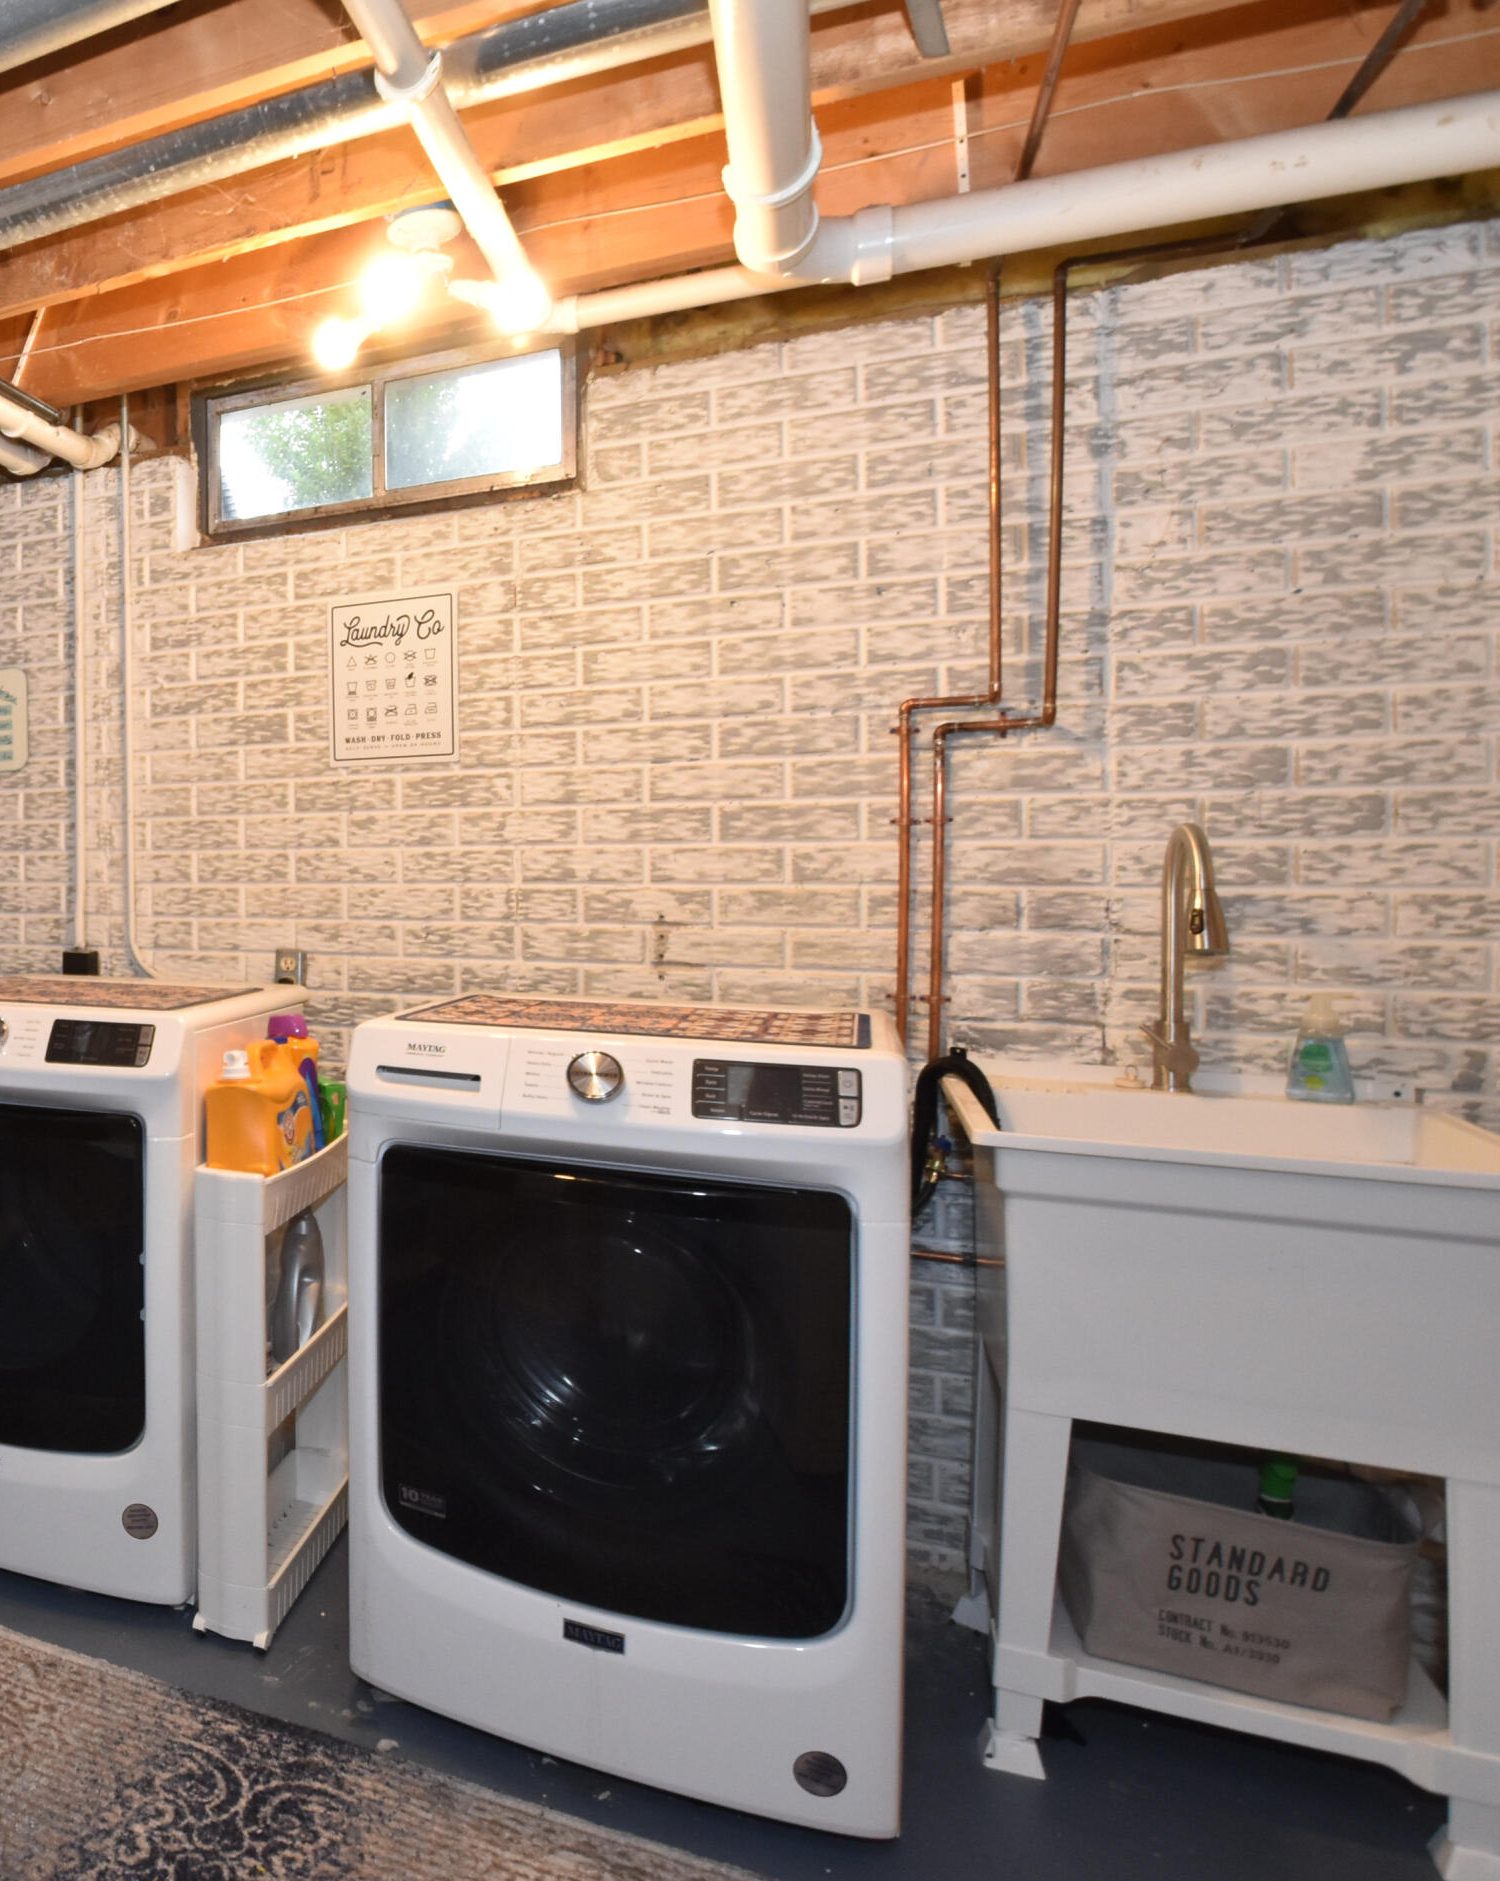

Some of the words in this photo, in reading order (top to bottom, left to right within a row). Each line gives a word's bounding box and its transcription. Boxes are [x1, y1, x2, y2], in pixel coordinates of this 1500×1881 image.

[340, 614, 410, 647] Laundry
[414, 609, 445, 640] Co
[345, 736, 367, 745] WASH
[371, 735, 386, 743] DRY
[390, 733, 411, 742] FOLD
[415, 731, 442, 740] PRESS
[407, 1043, 446, 1053] MAYTAG
[401, 1486, 420, 1502] 10
[1168, 1534, 1331, 1593] STANDARD
[1167, 1563, 1261, 1606] GOODS
[1159, 1609, 1213, 1634] CONTRACT
[566, 1624, 621, 1650] MAYTAG
[1159, 1624, 1192, 1645] STOCK
